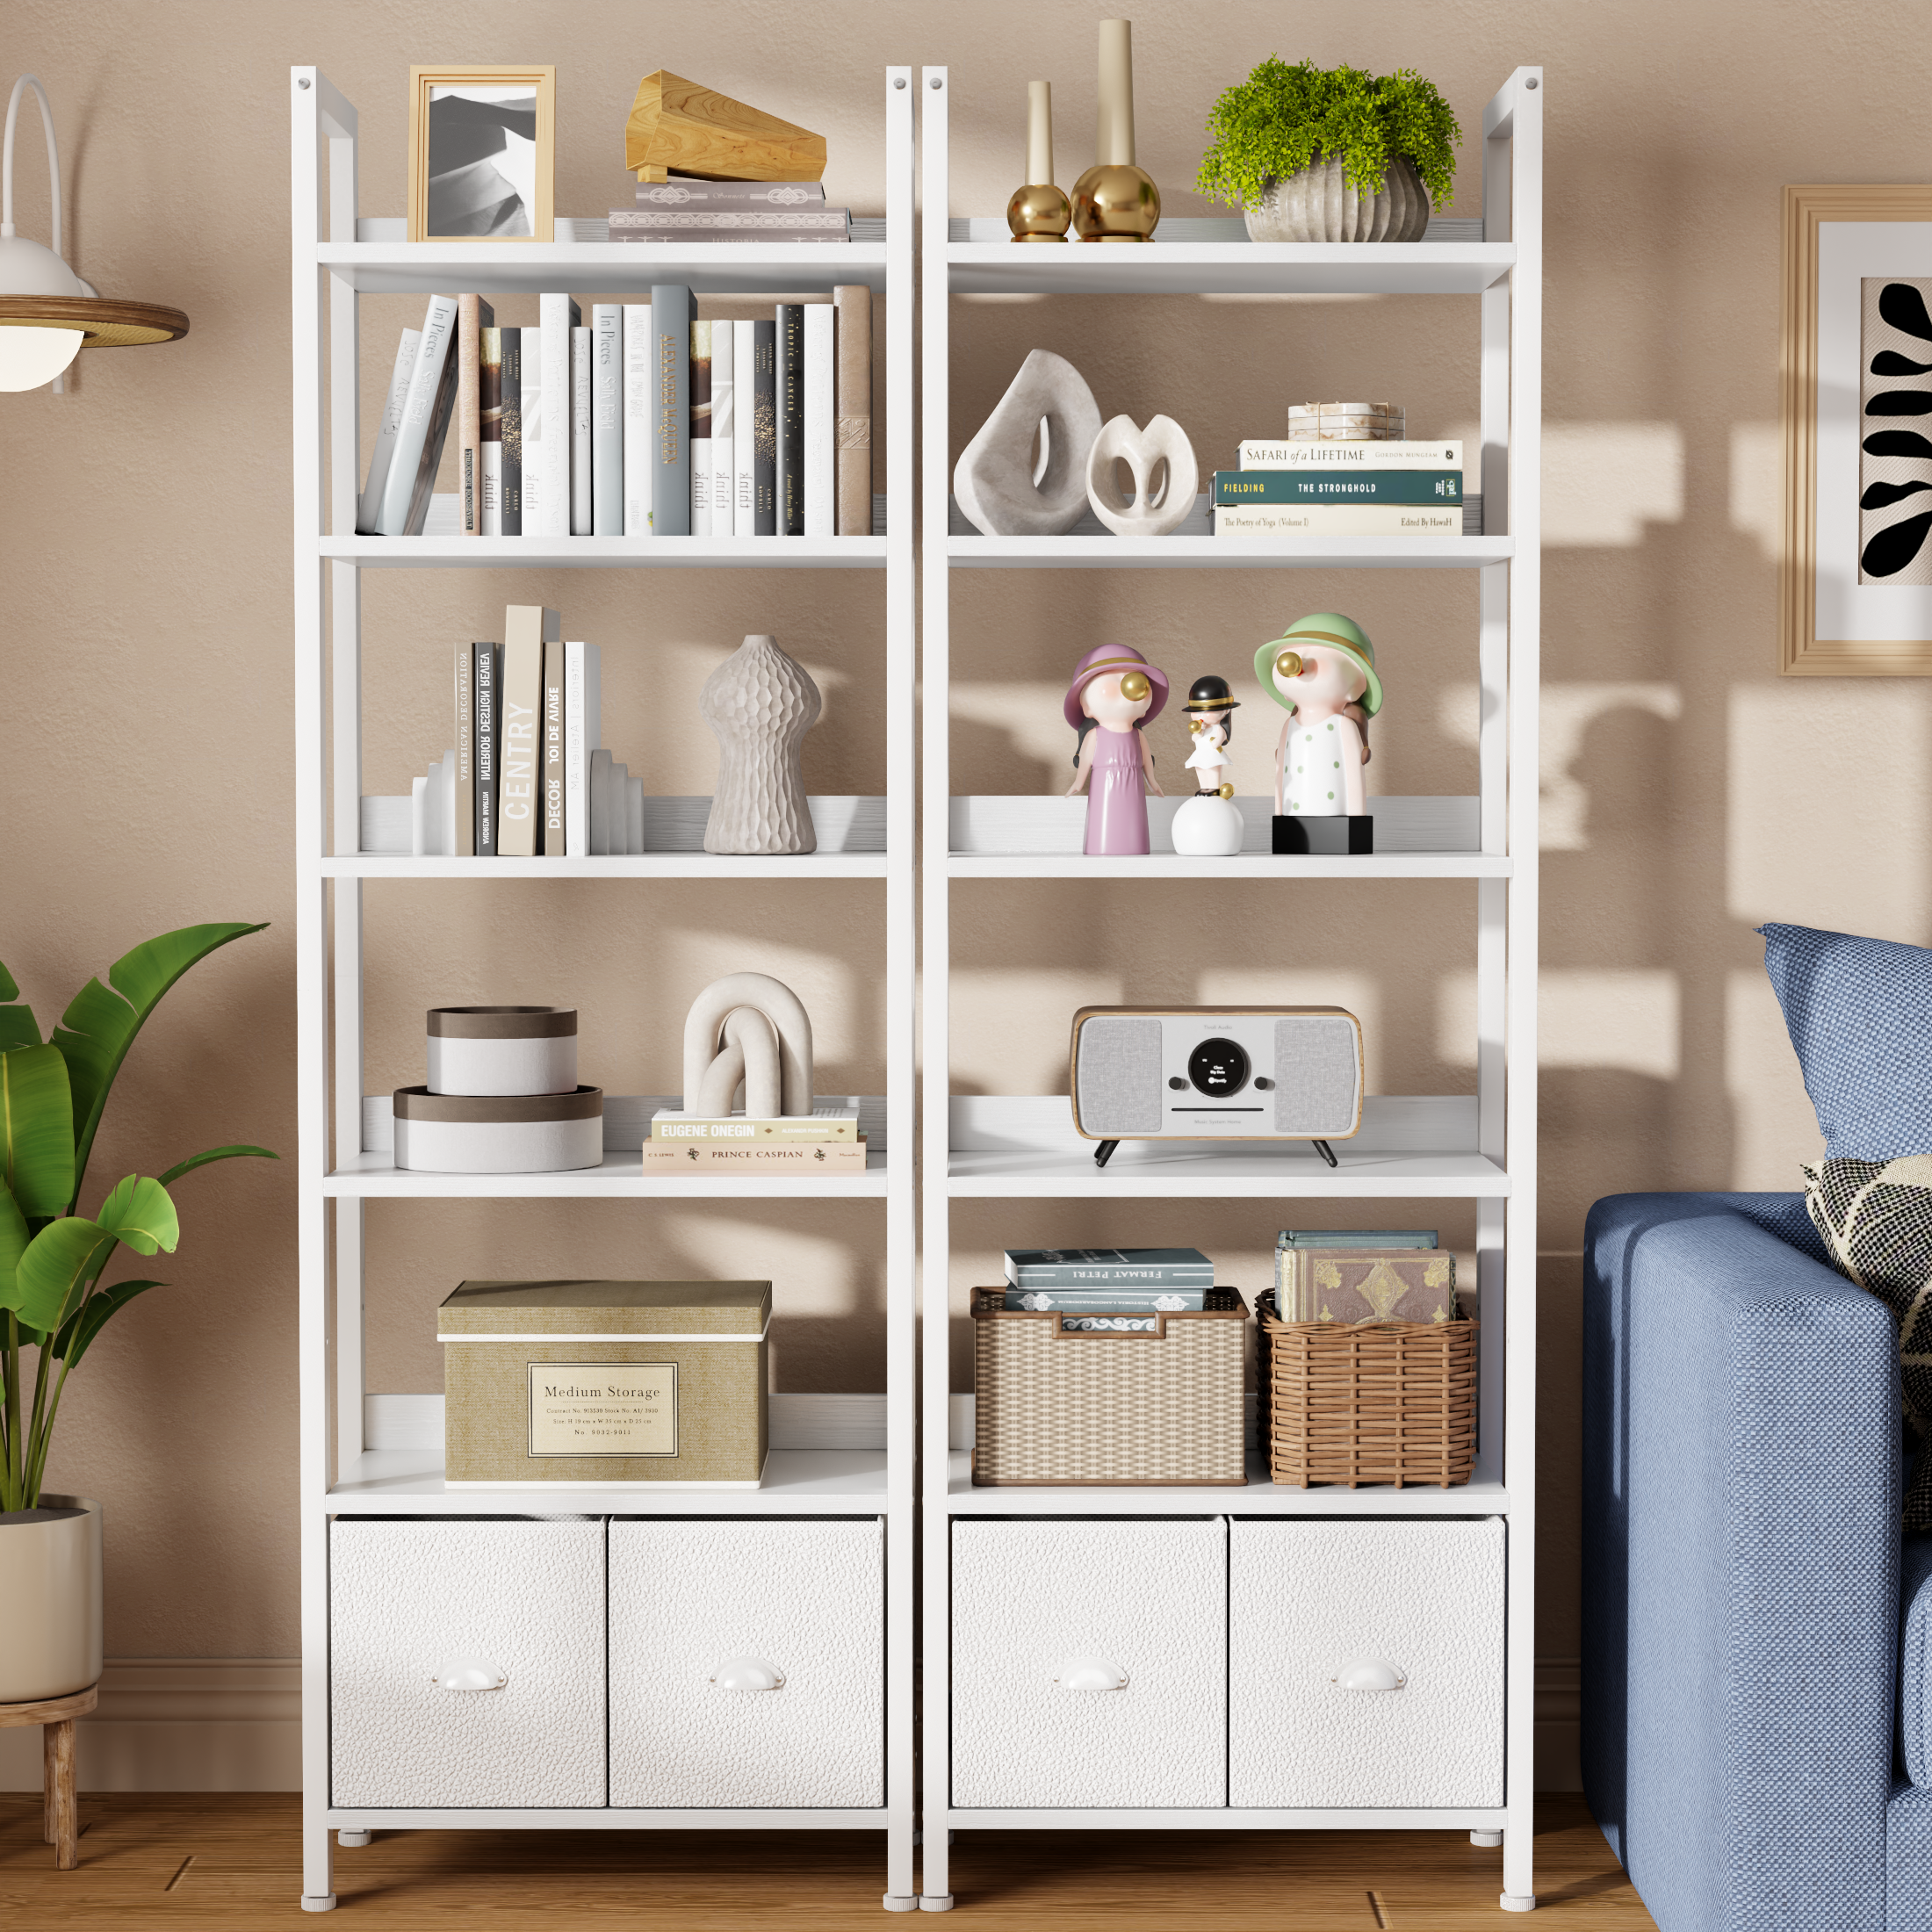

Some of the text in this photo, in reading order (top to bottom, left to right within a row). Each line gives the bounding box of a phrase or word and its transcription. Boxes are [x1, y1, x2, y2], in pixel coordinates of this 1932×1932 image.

[436, 307, 450, 320] In
[424, 325, 446, 358] Pieces
[599, 315, 616, 429] In Pieces Sally Field
[657, 334, 678, 465] ALEXANDER McQUEEN
[1247, 449, 1287, 461] SAFARI
[1290, 449, 1301, 463] of
[1310, 449, 1365, 461] LIFETIME
[1224, 484, 1265, 493] FIELDING
[1298, 483, 1376, 493] THE STRONGHOLD
[1224, 517, 1235, 526] The
[1236, 517, 1254, 528] Poetry
[1255, 517, 1262, 526] of
[1262, 518, 1276, 528] Yoga
[1279, 517, 1301, 527] (Volume
[1401, 517, 1419, 526] Edited
[1421, 517, 1429, 529] By
[505, 702, 533, 820] CENTRY
[661, 1125, 754, 1137] EUGENE ONEGIN
[544, 1386, 660, 1401] Medium Storage
